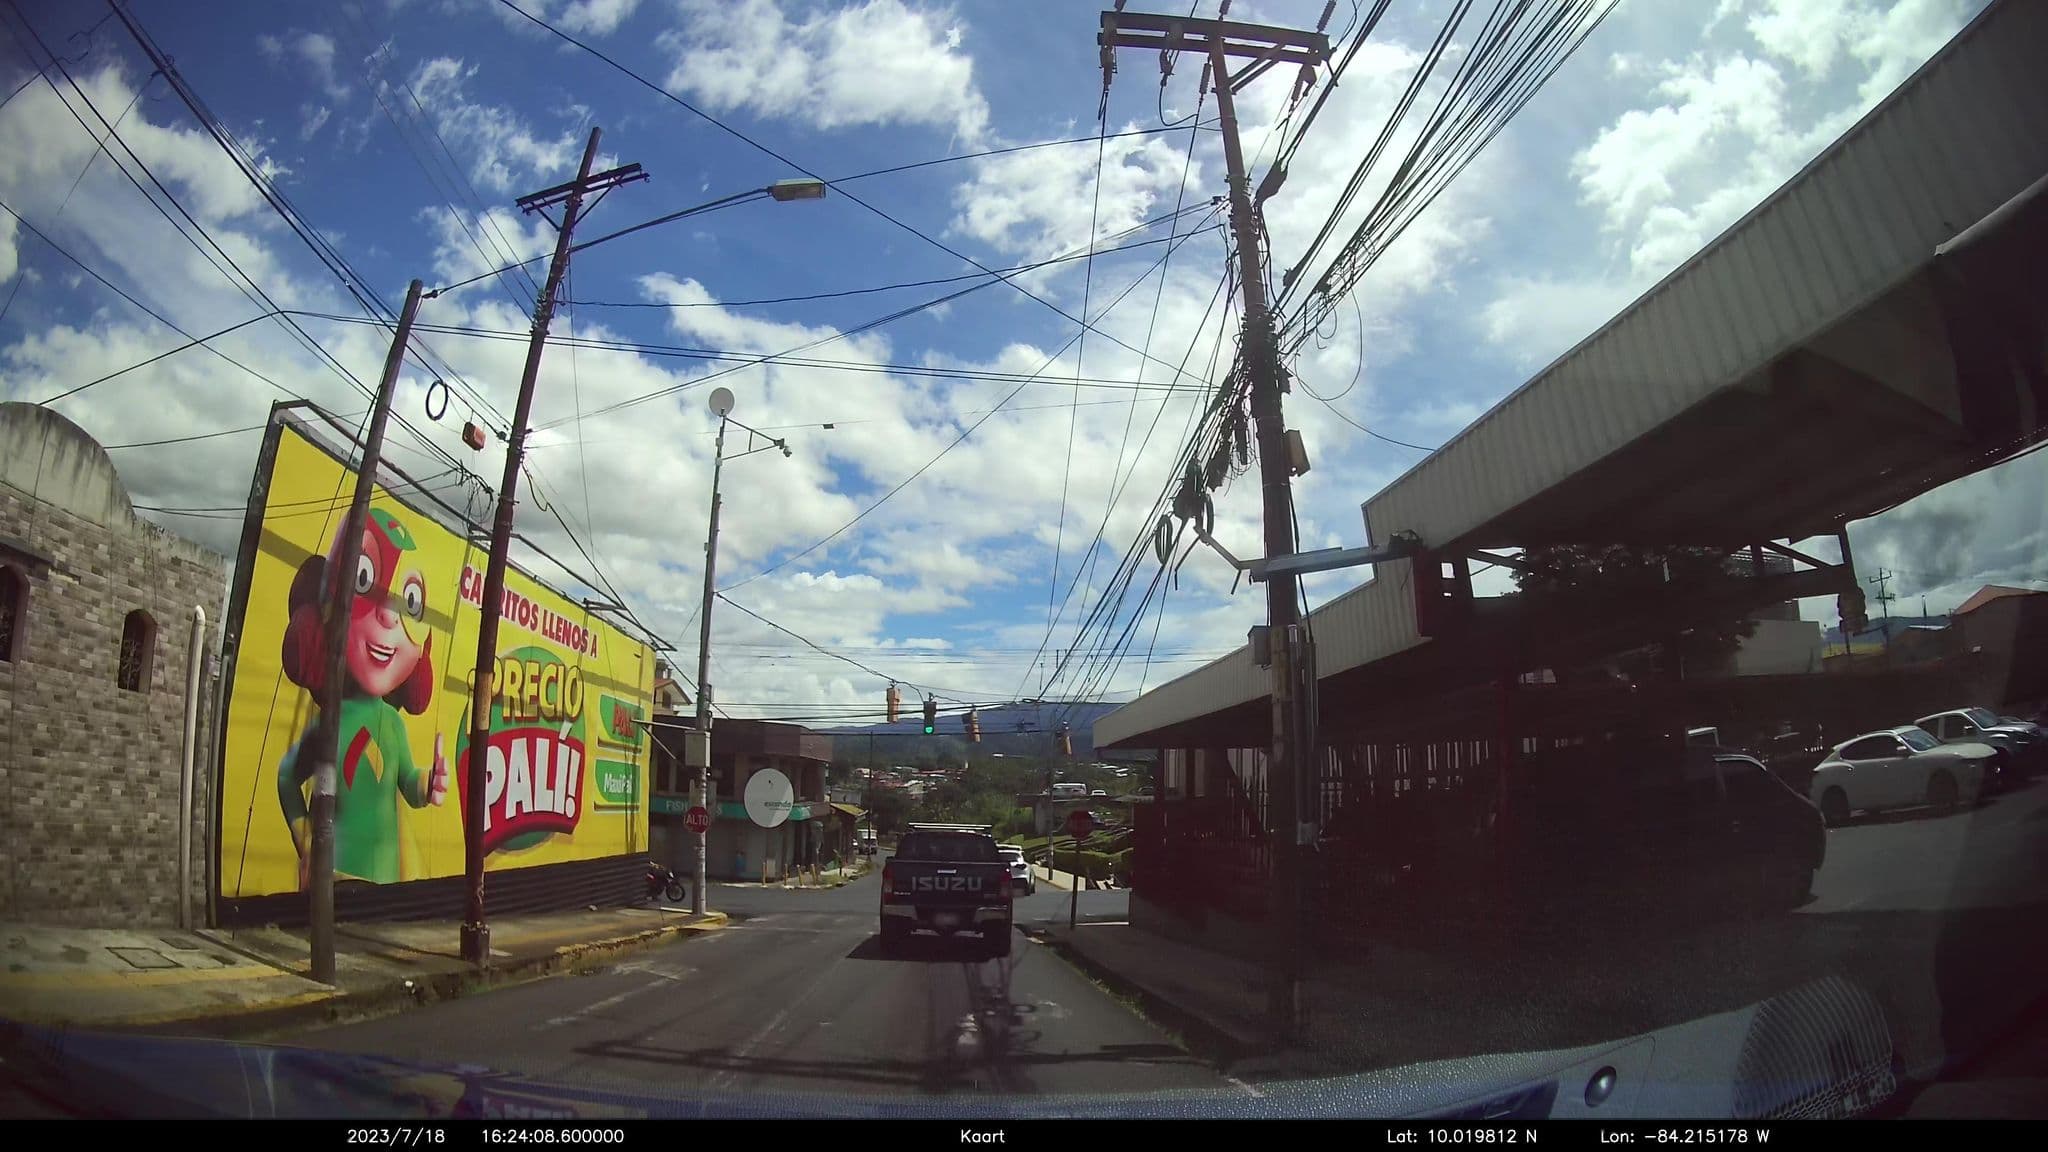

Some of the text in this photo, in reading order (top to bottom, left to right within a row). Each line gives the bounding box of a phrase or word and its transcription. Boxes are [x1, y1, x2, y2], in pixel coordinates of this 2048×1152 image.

[460, 565, 598, 659] CARITOS LLENOS A
[483, 720, 581, 832] PALÍ!
[686, 814, 709, 826] ALTO
[911, 876, 983, 892] ISUZU
